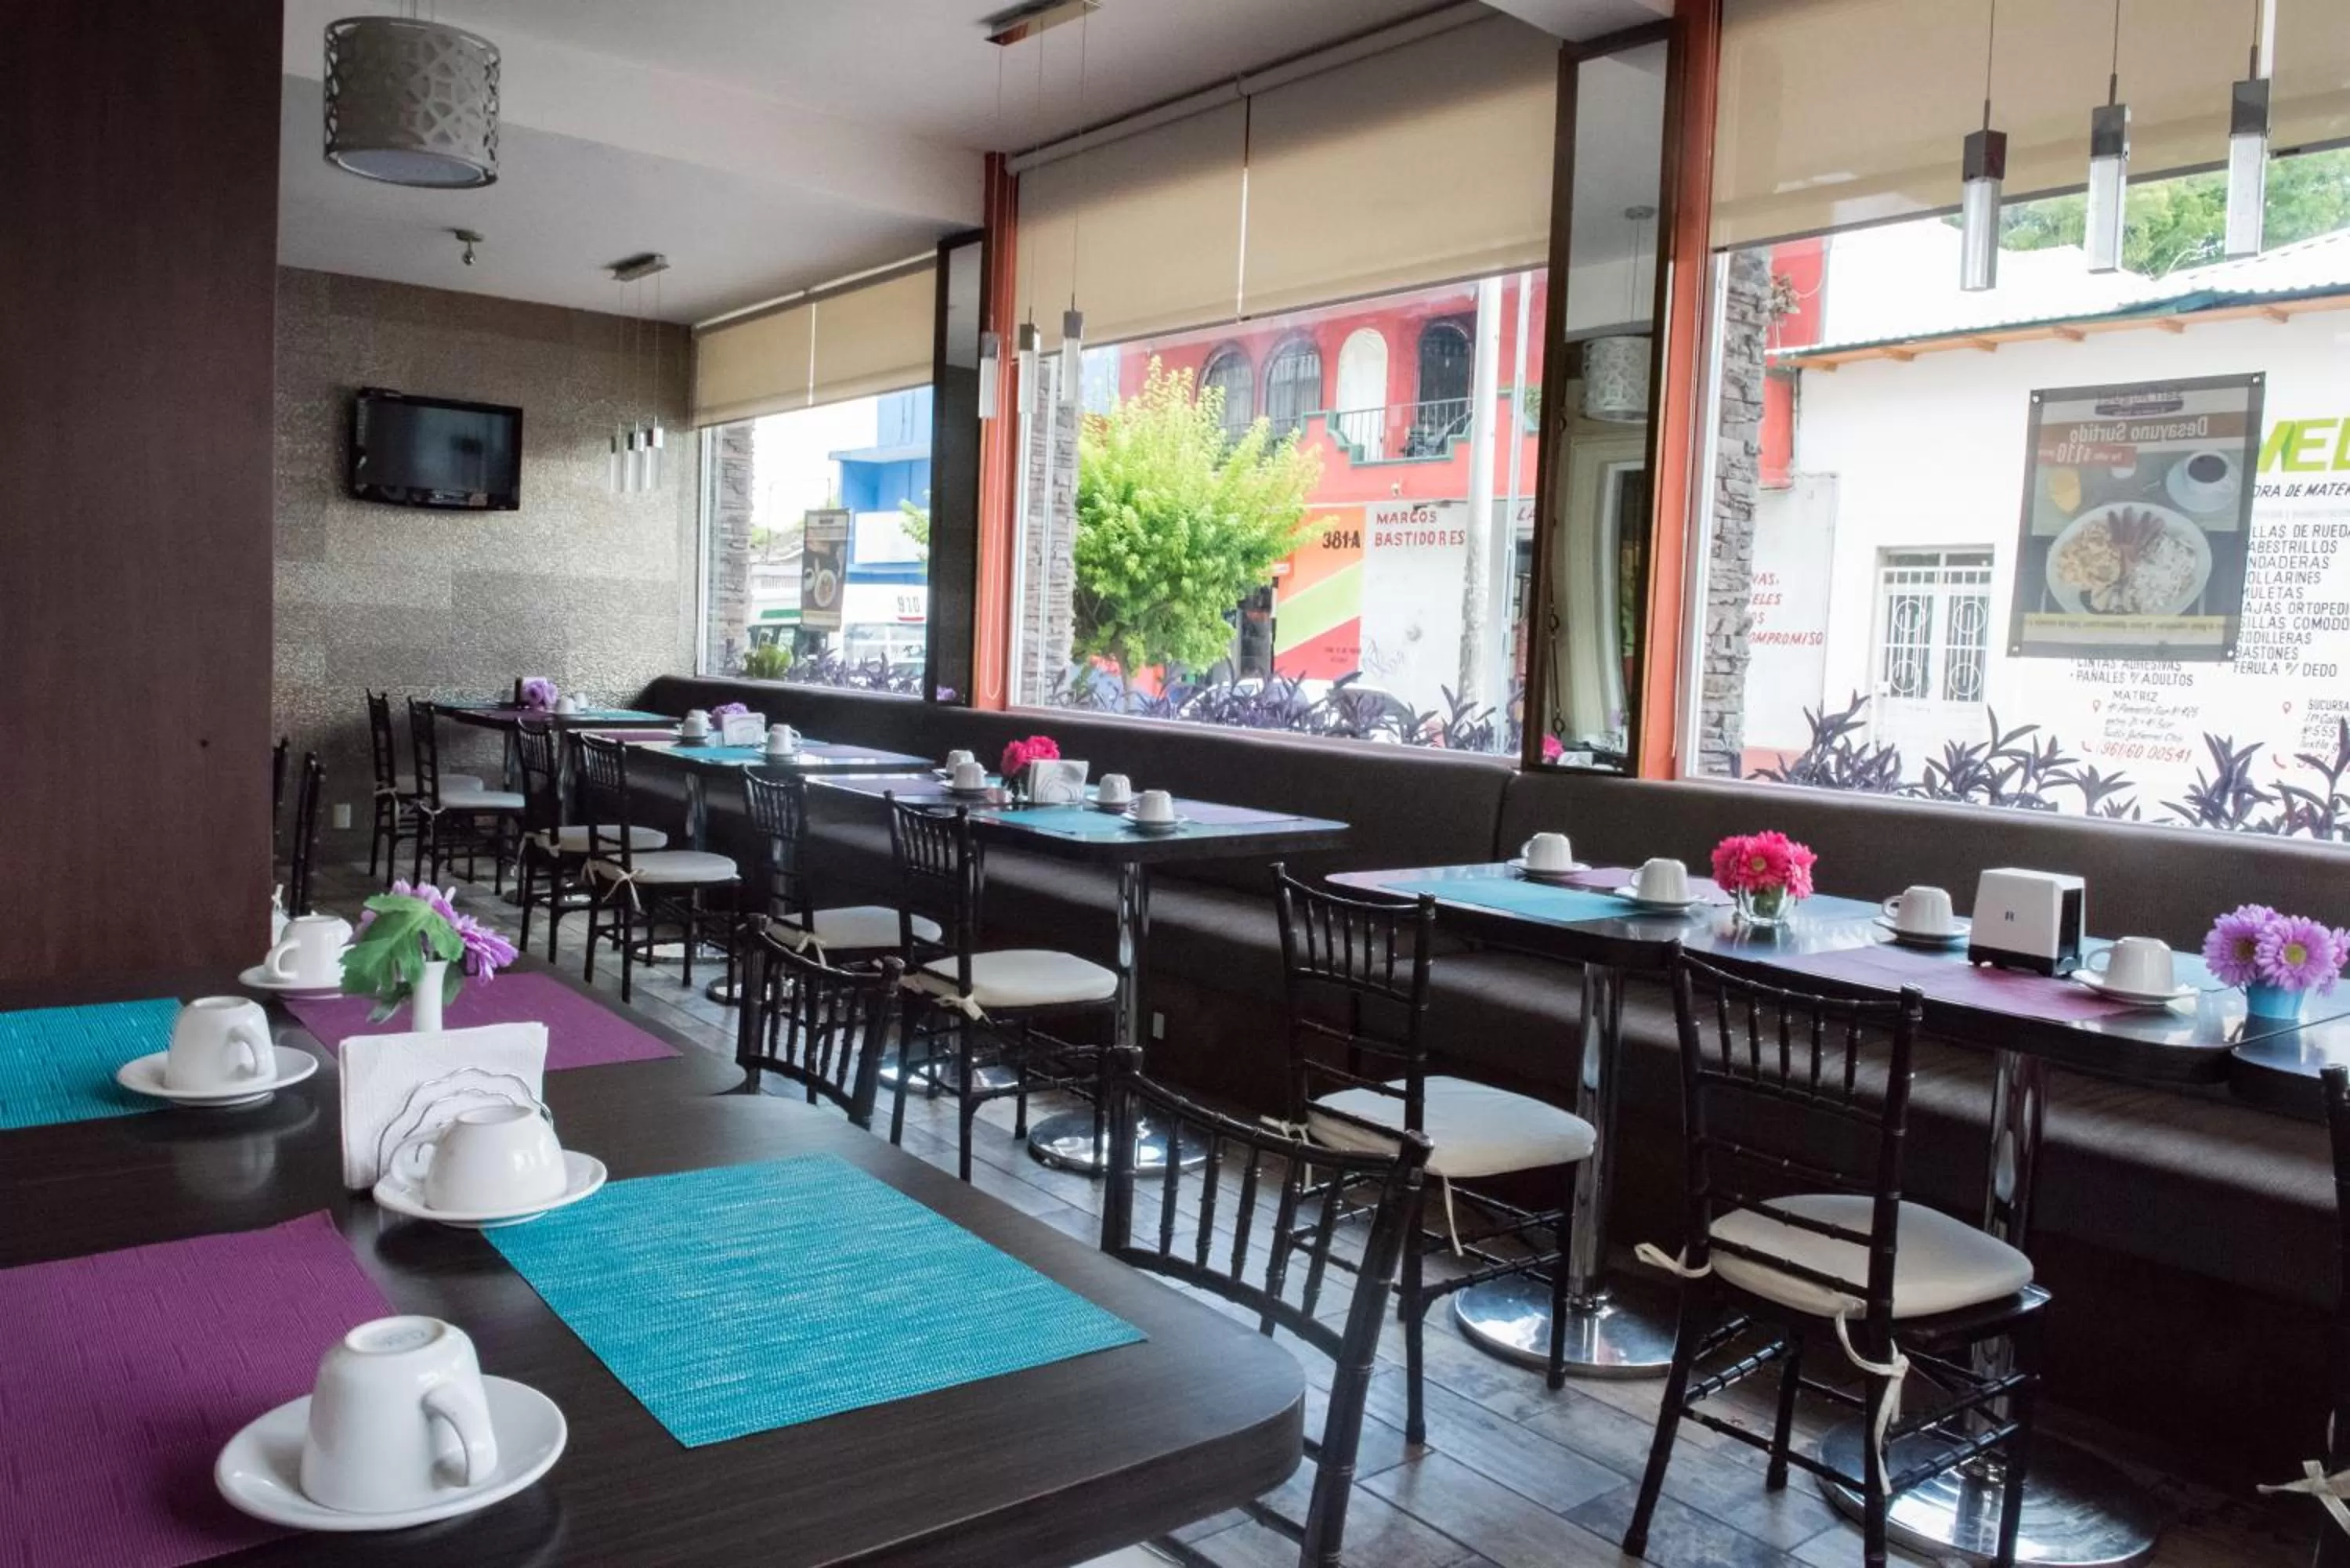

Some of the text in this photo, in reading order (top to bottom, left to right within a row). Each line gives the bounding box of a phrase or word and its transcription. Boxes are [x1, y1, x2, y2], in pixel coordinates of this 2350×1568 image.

[2284, 483, 2301, 497] DE
[1376, 510, 1437, 524] MARCOS
[1375, 529, 1466, 547] BASTIDORES
[2293, 524, 2309, 538] DE
[2247, 555, 2330, 569] NDADERAS
[2247, 571, 2322, 585] OLLARINES
[2243, 601, 2282, 615] AJAS
[2237, 630, 2312, 645] RODILLERAS
[2235, 645, 2299, 661] BASTONES
[2232, 661, 2280, 676] FERULA
[2301, 663, 2338, 677] DEDO
[2141, 672, 2194, 687] ADULTOS
[2112, 689, 2159, 703] MATRIZ
